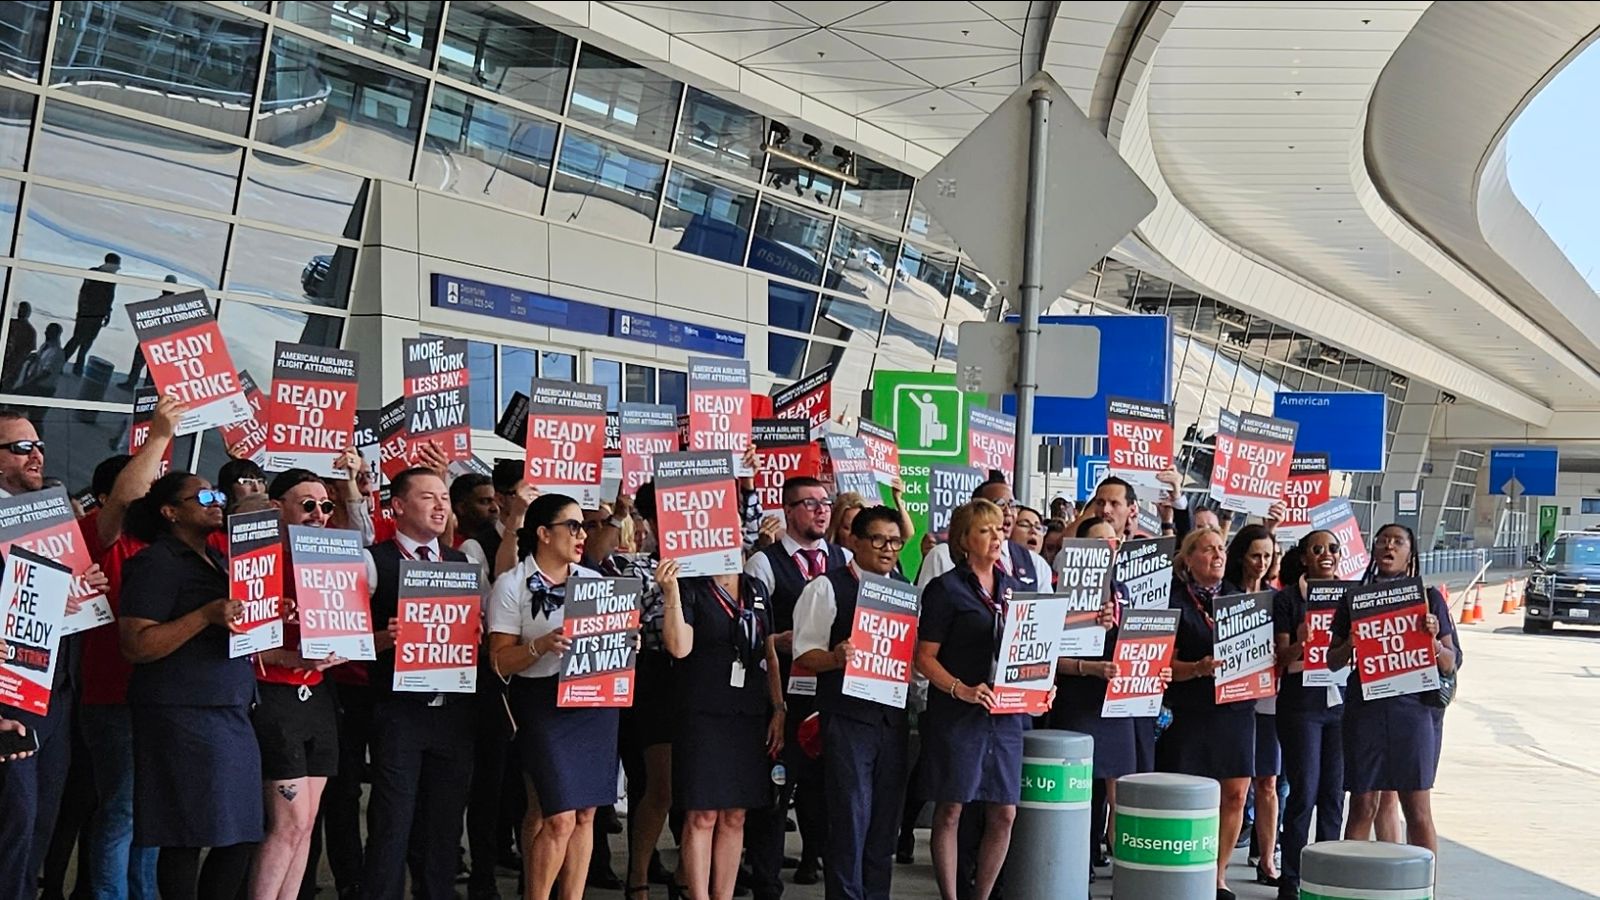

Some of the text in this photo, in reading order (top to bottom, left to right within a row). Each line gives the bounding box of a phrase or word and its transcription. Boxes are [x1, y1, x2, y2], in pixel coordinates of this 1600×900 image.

[149, 333, 213, 365] READY
[281, 351, 353, 368] AMERICAN AIRLINES
[409, 340, 444, 361] MORE
[174, 357, 205, 380] TO
[278, 359, 303, 369] FLIGHT
[430, 353, 464, 374] WORK
[164, 371, 236, 402] STRIKE
[412, 371, 463, 394] LESS PAY:
[277, 383, 346, 410] READY
[417, 390, 459, 412] IT'S THE
[533, 395, 558, 405] FLIGHT
[536, 387, 602, 401] AMERICAN AIRLINES
[694, 394, 744, 415] READY
[1280, 396, 1330, 406] American
[296, 405, 324, 427] TO
[411, 404, 465, 433] AA WAY
[709, 413, 730, 432] TO
[272, 423, 348, 450] STRIKE
[533, 418, 596, 443] READY
[694, 431, 749, 451] STRIKE
[1113, 422, 1163, 442] READY
[550, 440, 576, 460] TO
[626, 437, 672, 454] READY
[873, 449, 885, 460] TO
[972, 432, 1014, 457] READY
[1128, 438, 1149, 453] TO
[1237, 443, 1286, 467] READY
[529, 457, 597, 482] STRIKE
[660, 458, 727, 469] AMERICAN AIRLINES
[757, 453, 801, 471] EADY
[869, 456, 897, 475] TRIKE
[985, 450, 1001, 468] TO
[1114, 450, 1168, 469] STRIKE
[1249, 461, 1268, 478] TO
[658, 468, 682, 477] FLIGHT
[761, 471, 785, 487] TO
[1230, 473, 1283, 497] STRIKE
[1285, 480, 1322, 494] EADY
[34, 498, 64, 511] AIRLINES
[662, 489, 726, 512] READY
[934, 488, 953, 507] TO
[1288, 494, 1308, 508] TO
[906, 502, 929, 515] rop
[682, 510, 709, 530] TO
[295, 543, 318, 552] FLIGHT
[296, 535, 358, 548] AMERICAN AIRLINES
[665, 527, 735, 550] STRIKE
[1065, 547, 1111, 568] TRYING
[1116, 543, 1157, 564] AA makes
[14, 560, 37, 588] WE
[234, 554, 276, 582] READY
[406, 569, 476, 580] AMERICAN AIRLINES
[1116, 553, 1172, 582] billions.
[1337, 553, 1365, 576] TRIKE
[301, 568, 358, 591] READY
[404, 578, 429, 587] FLIGHT
[1063, 568, 1107, 587] TO GET
[1131, 577, 1153, 593] can't
[246, 578, 264, 600] TO
[319, 589, 345, 610] TO
[574, 579, 614, 601] MORE
[1141, 582, 1167, 605] rent
[1353, 585, 1418, 602] AMERICAN AIRLINES
[9, 585, 39, 616] ARE
[596, 593, 636, 615] WORK
[1216, 598, 1255, 621] AA makes
[1352, 600, 1375, 610] FLIGHT
[305, 609, 368, 632] STRIKE
[405, 602, 471, 624] READY
[1016, 603, 1036, 621] WE
[5, 613, 53, 646] READY
[423, 623, 450, 643] TO
[572, 612, 632, 635] LESS PAY:
[858, 611, 910, 642] READY
[1012, 622, 1039, 641] ARE
[1218, 608, 1272, 640] billions.
[1358, 613, 1419, 640] READY
[402, 642, 473, 664] STRIKE
[576, 631, 626, 654] IT'S THE
[872, 634, 891, 657] TO
[1009, 641, 1052, 662] READY
[1120, 643, 1167, 660] READY
[1219, 634, 1256, 657] We can't
[1378, 635, 1404, 654] TO
[566, 646, 631, 677] AA WAY
[851, 649, 907, 681] STRIKE
[1130, 660, 1149, 676] TO
[1222, 639, 1271, 677] pay rent
[1363, 648, 1430, 675] STRIKE
[1006, 668, 1018, 680] TO
[1112, 676, 1162, 694] STRIKE
[1037, 777, 1056, 792] Up
[1122, 832, 1199, 855] Passenger
